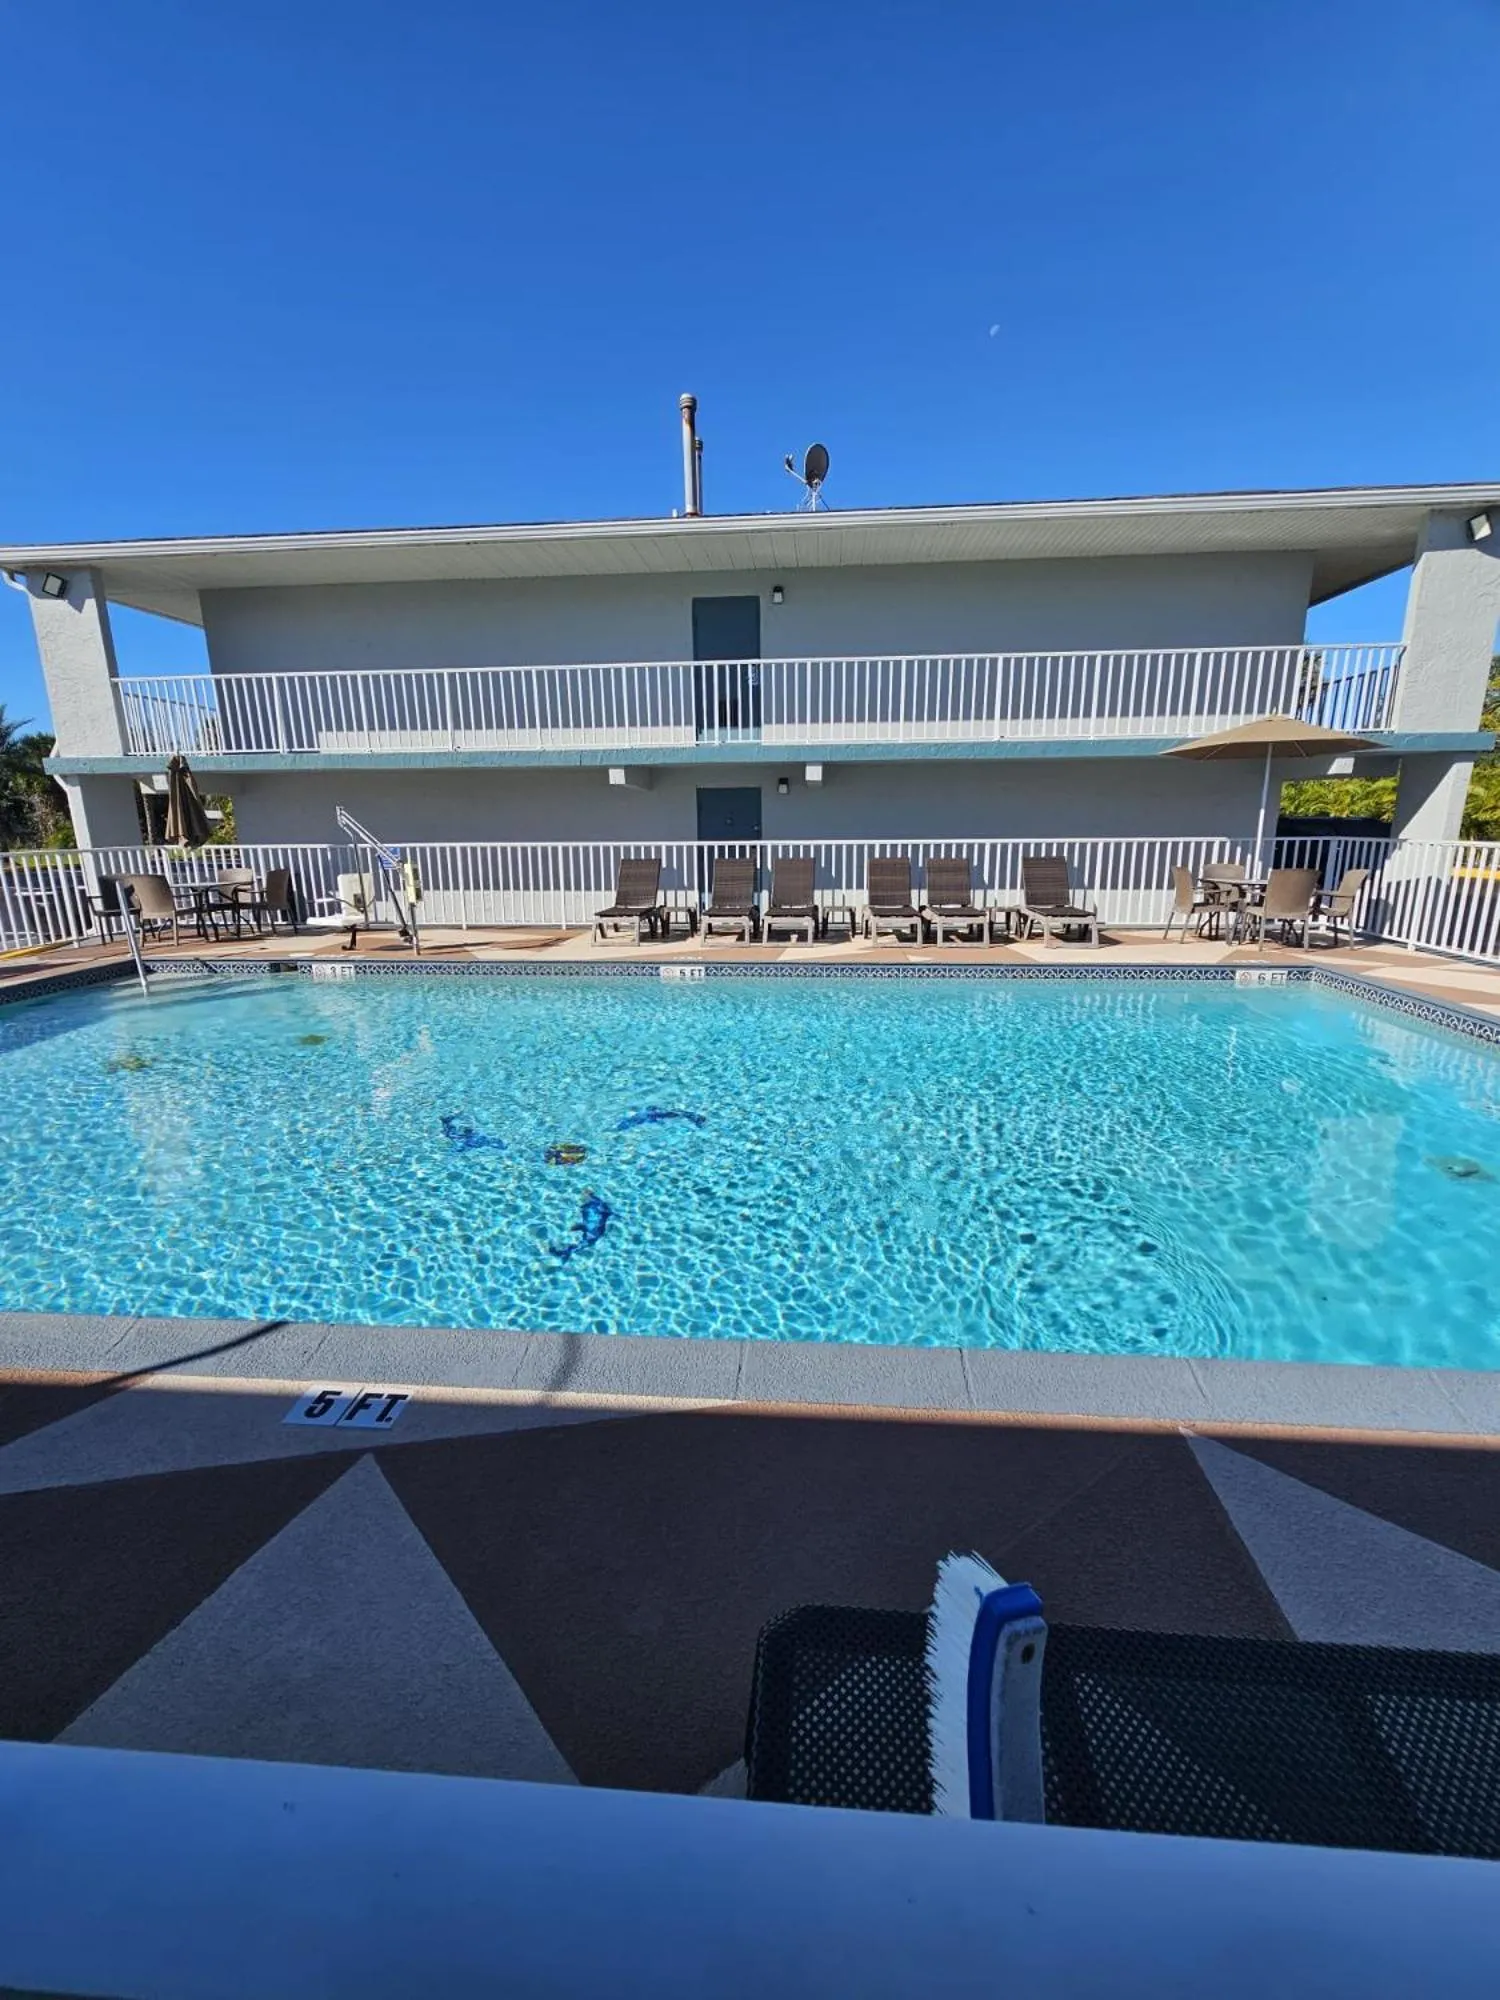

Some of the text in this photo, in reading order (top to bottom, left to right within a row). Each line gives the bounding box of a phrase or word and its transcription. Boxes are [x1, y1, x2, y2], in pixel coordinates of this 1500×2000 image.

[679, 969, 702, 978] 5 FT
[1258, 973, 1286, 982] 6 FT
[304, 1390, 409, 1422] 5 FT.
